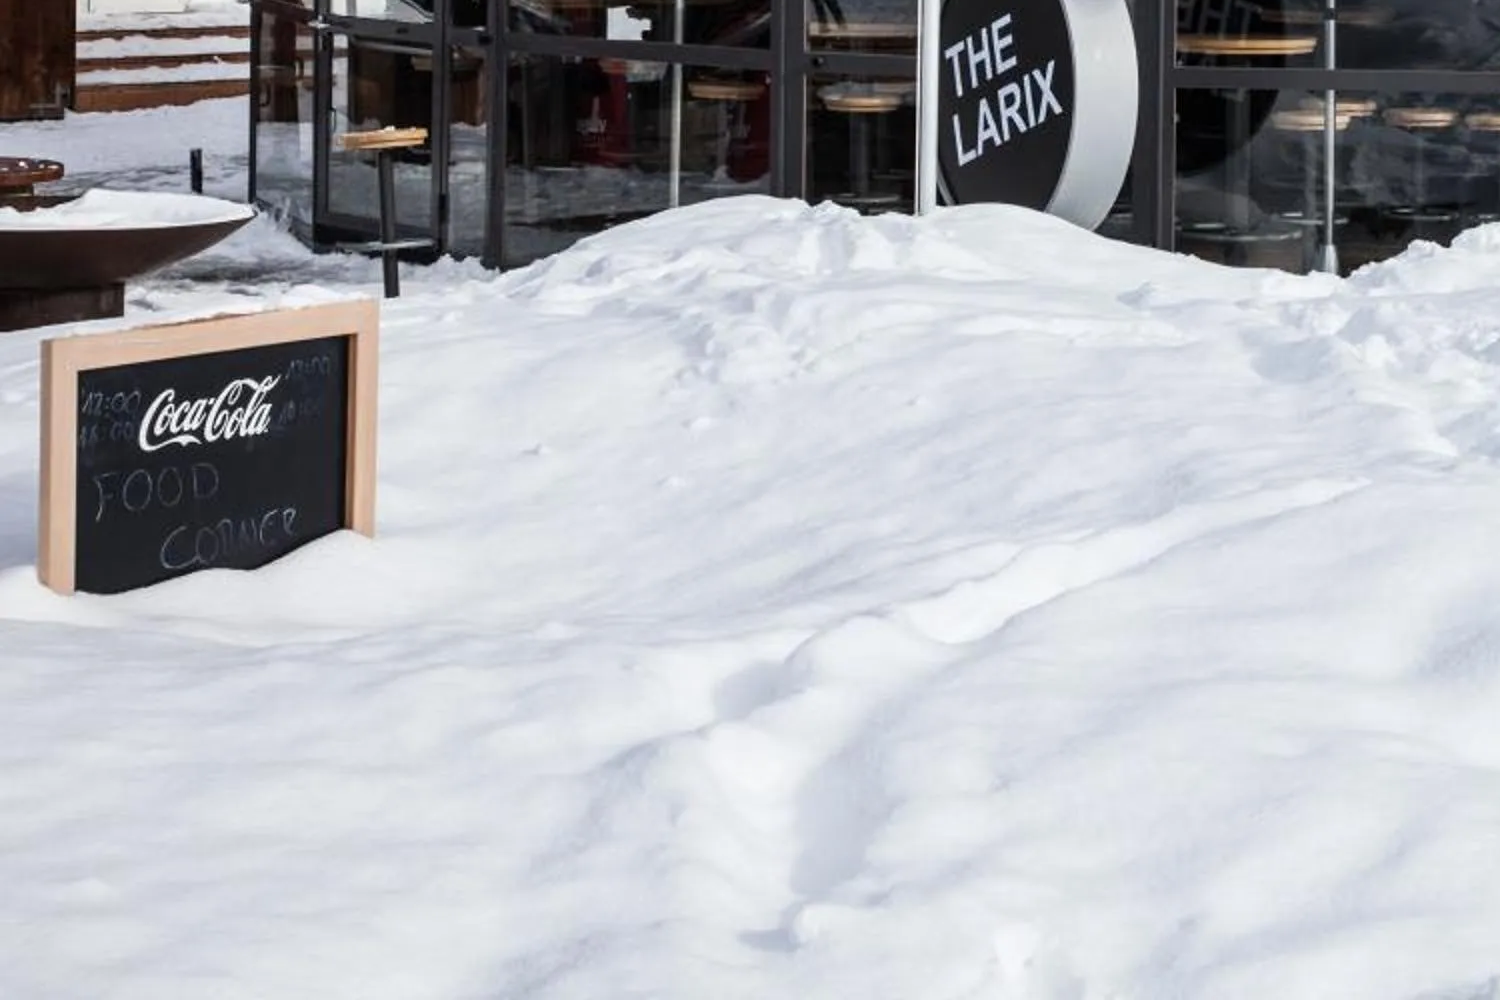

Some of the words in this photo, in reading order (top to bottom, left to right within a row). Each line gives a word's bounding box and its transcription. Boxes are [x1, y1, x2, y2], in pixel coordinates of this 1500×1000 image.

[945, 13, 1018, 98] THE
[952, 59, 1064, 167] LARIX
[93, 462, 220, 524] FOOD
